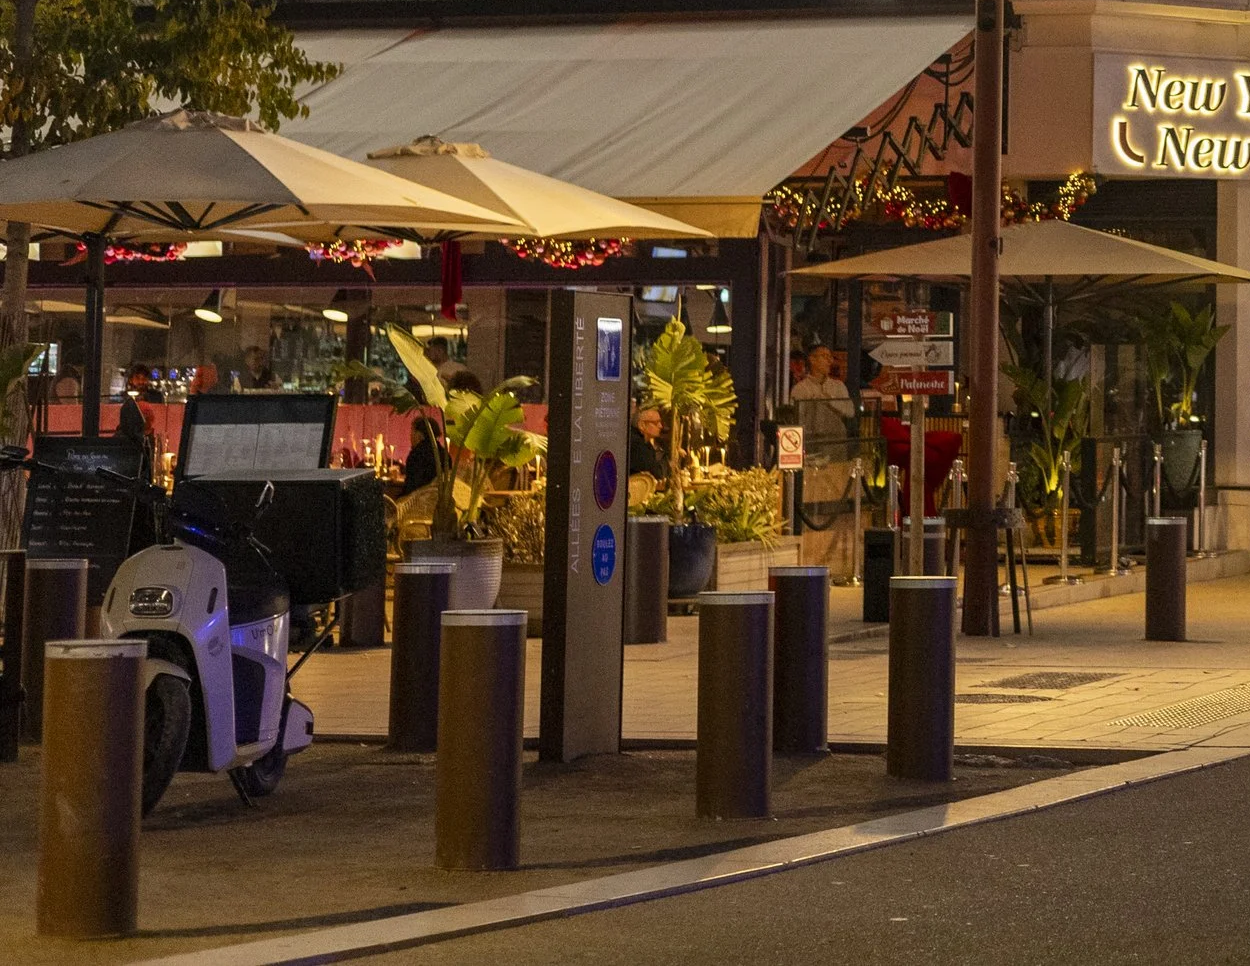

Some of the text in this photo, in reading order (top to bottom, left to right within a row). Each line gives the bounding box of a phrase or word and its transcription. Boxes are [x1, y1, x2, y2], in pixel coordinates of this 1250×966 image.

[1127, 66, 1227, 113] New
[896, 315, 929, 324] Marché
[897, 324, 929, 333] de Noël
[574, 317, 585, 409] LIBERTÉ
[573, 416, 582, 441] LA
[570, 488, 582, 574] ALLÉES
